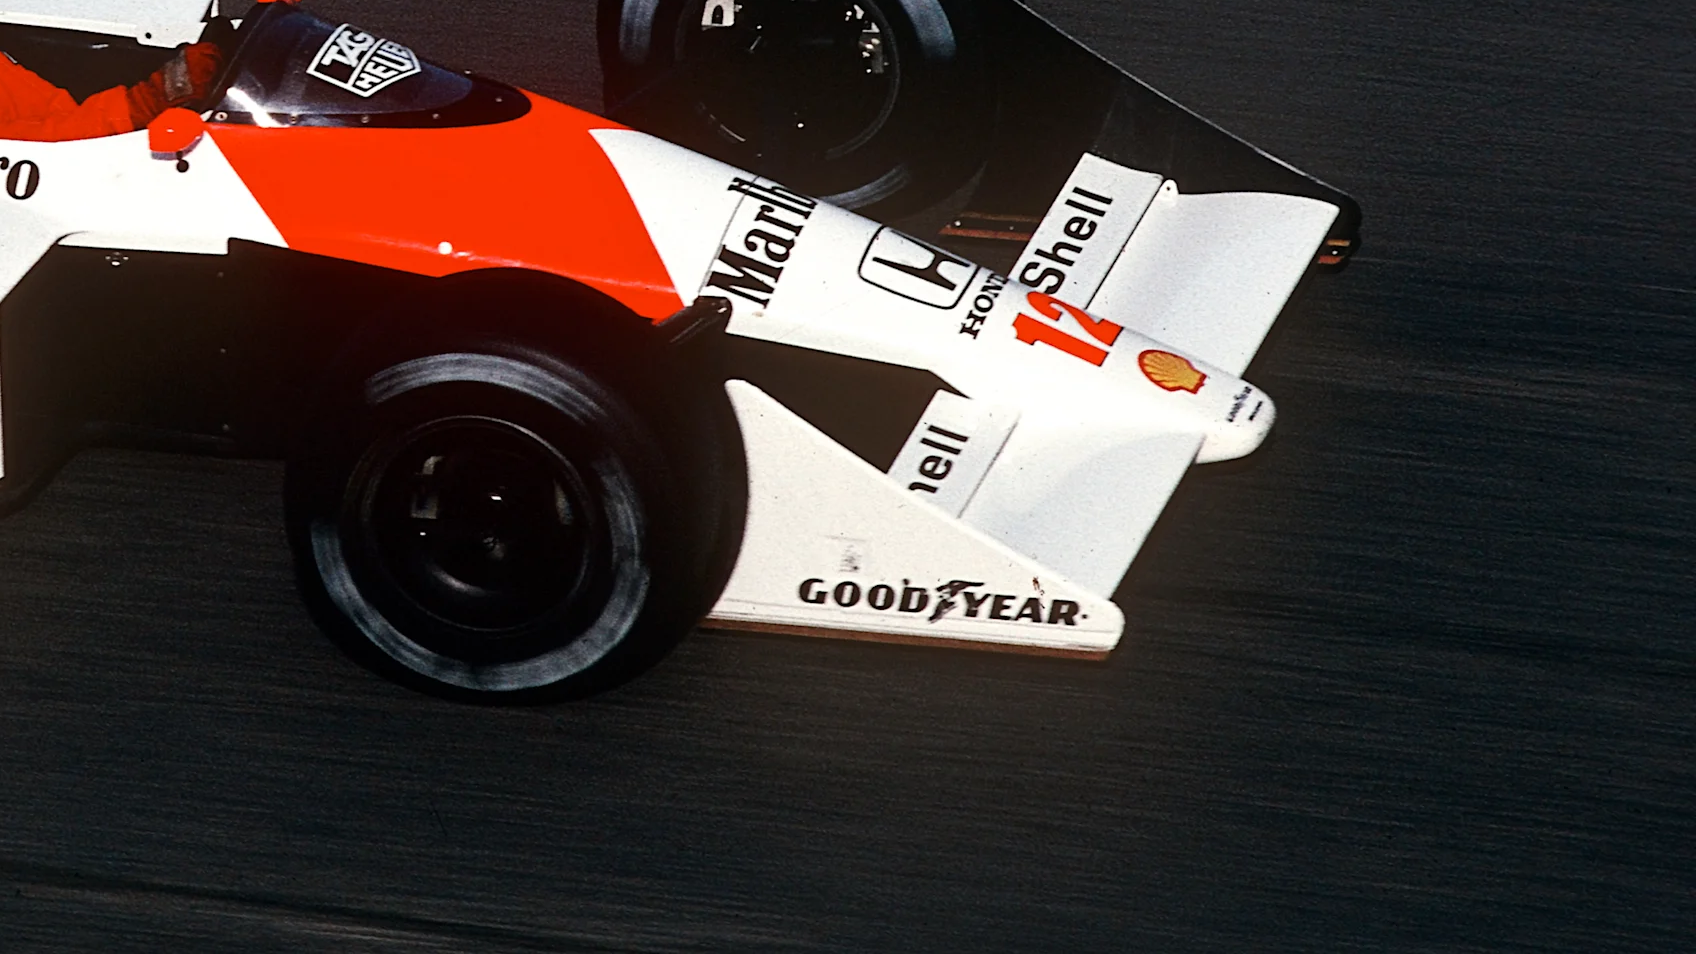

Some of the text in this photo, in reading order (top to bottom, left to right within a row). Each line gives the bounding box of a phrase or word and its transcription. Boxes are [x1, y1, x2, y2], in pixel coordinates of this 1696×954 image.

[320, 29, 375, 69] TAG
[1019, 186, 1114, 295] Shell
[1012, 290, 1125, 368] 12
